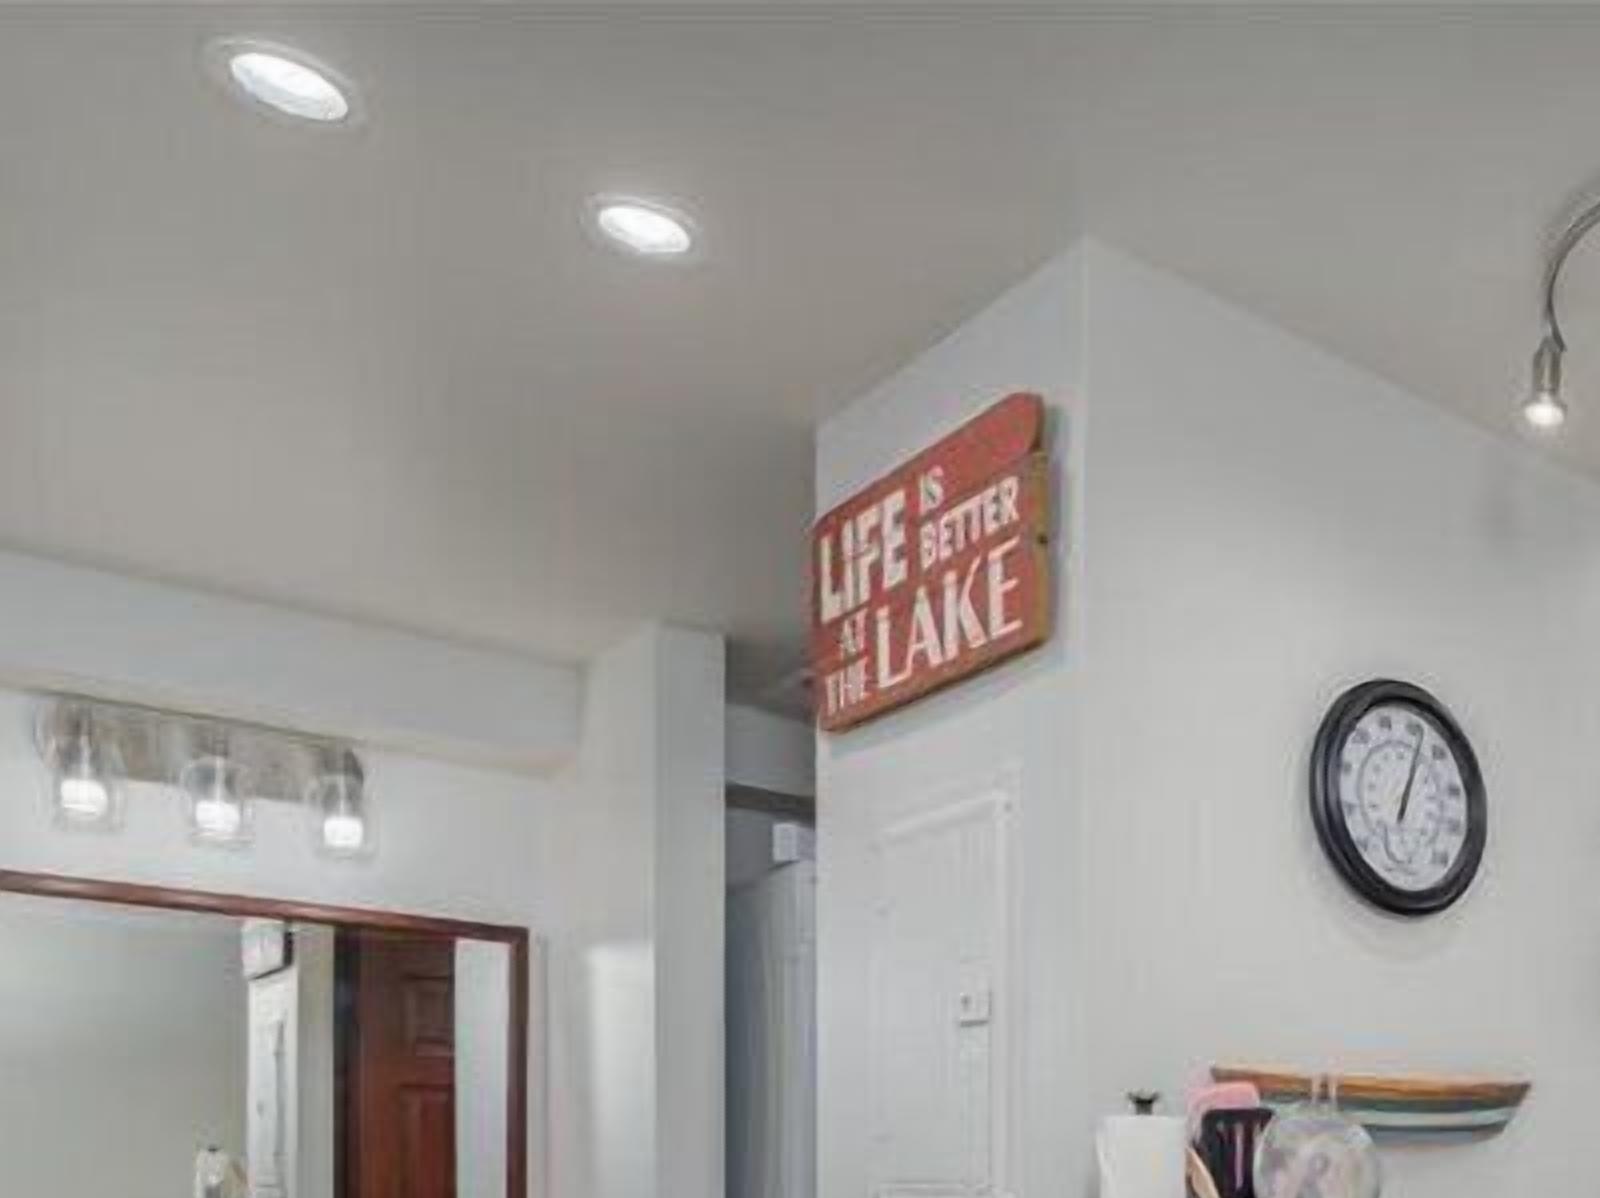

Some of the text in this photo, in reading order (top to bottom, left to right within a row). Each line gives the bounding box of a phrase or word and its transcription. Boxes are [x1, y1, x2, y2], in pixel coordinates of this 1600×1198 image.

[820, 465, 944, 624] LIFE IS
[919, 476, 1020, 570] BETTER
[825, 535, 1024, 716] THE LAKE
[840, 607, 868, 660] AT
